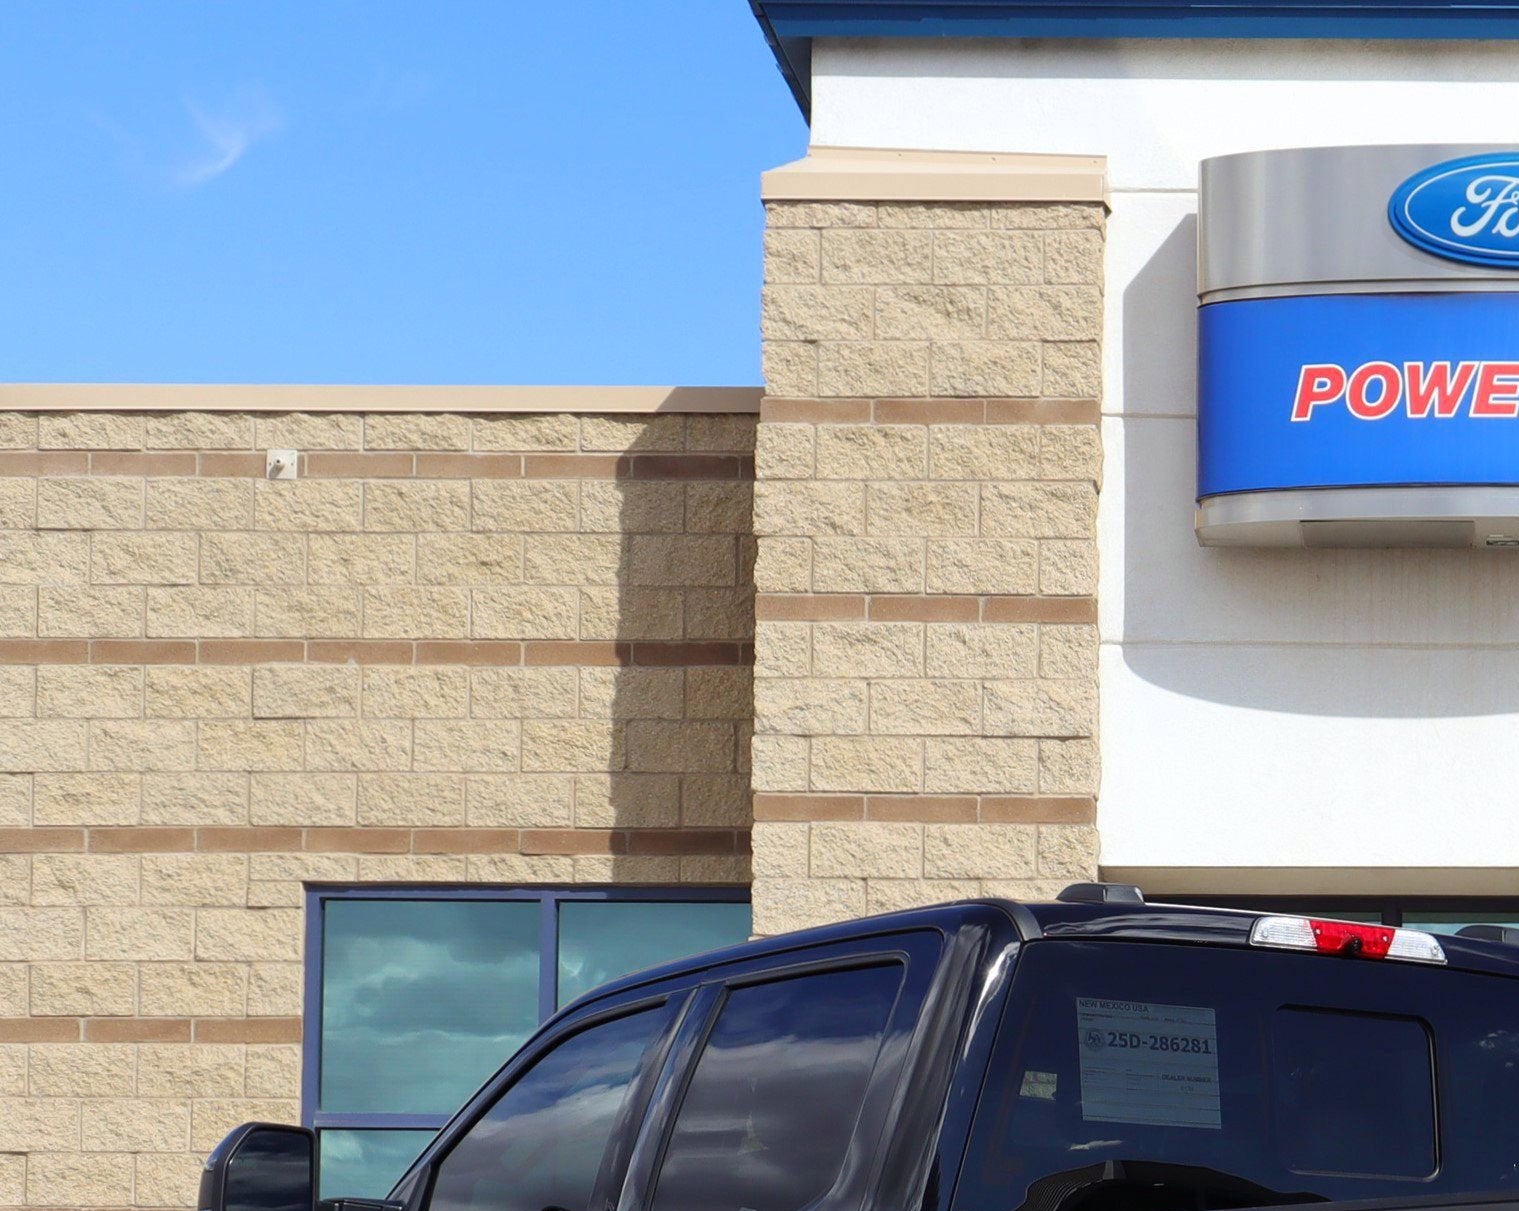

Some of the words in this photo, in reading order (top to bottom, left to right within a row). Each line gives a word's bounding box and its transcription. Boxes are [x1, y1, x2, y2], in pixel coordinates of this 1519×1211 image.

[1079, 1000, 1099, 1010] NEW
[1100, 1001, 1130, 1011] MEXICO
[1132, 1003, 1150, 1013] USA
[1107, 1031, 1213, 1055] 25D-286281
